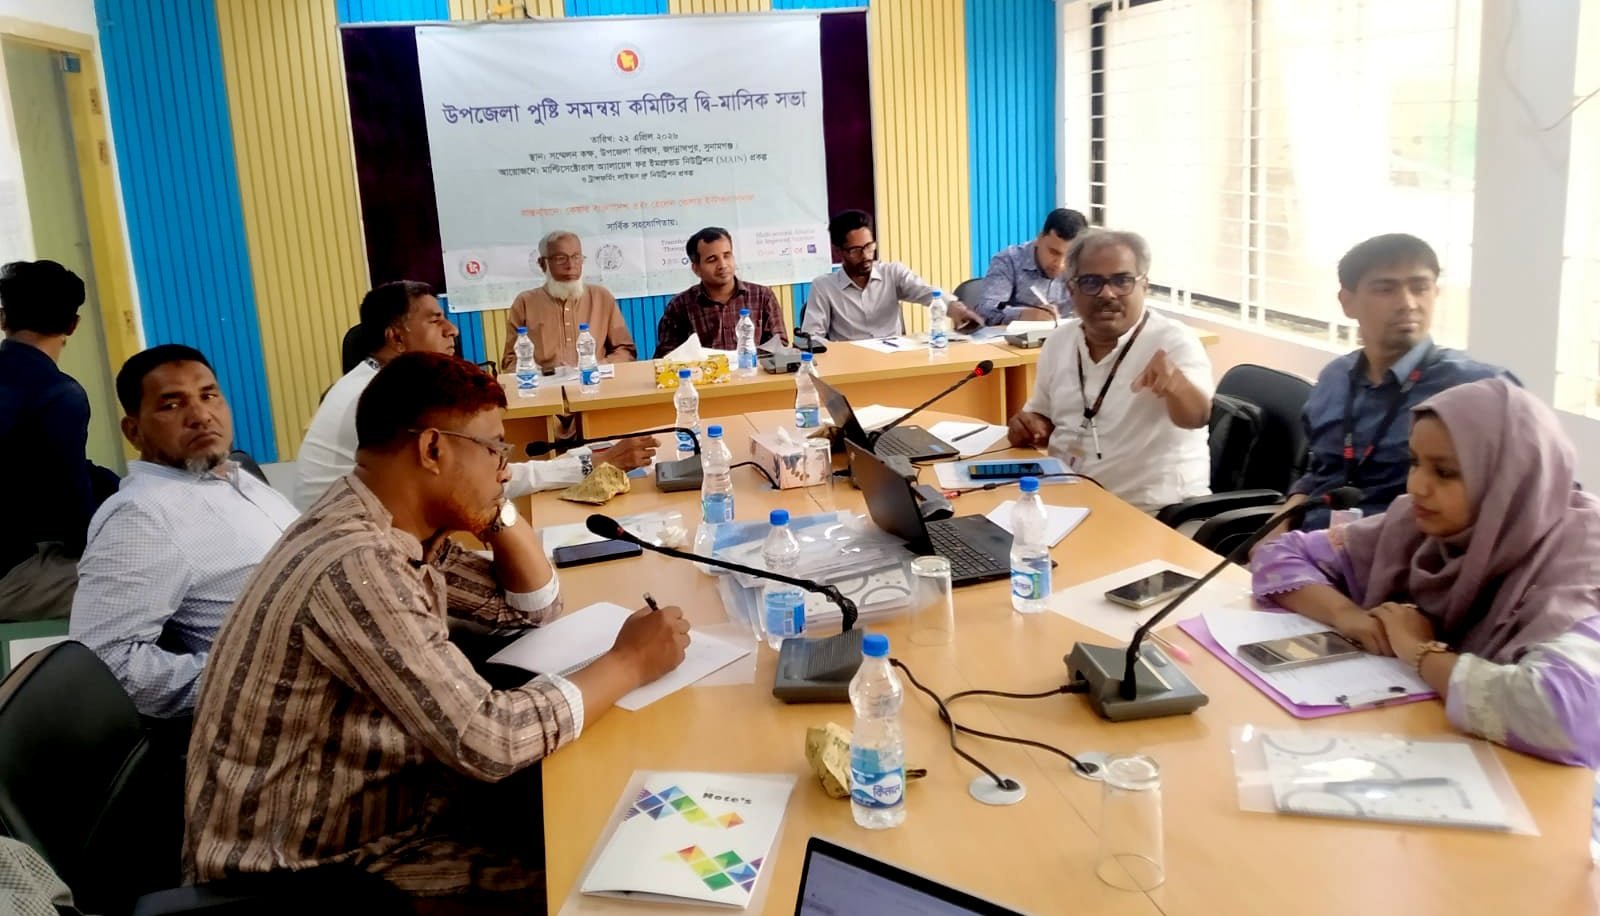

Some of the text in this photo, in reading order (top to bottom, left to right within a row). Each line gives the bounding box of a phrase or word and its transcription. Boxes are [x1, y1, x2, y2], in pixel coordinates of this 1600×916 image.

[442, 88, 807, 125] উপজেলা পুষ্টি সমন্বয় কমিটির দ্বি-মাসিক সভা
[600, 147, 631, 157] উপজেলা
[716, 154, 748, 165] (MAIN)
[606, 220, 630, 232] সার্বিক
